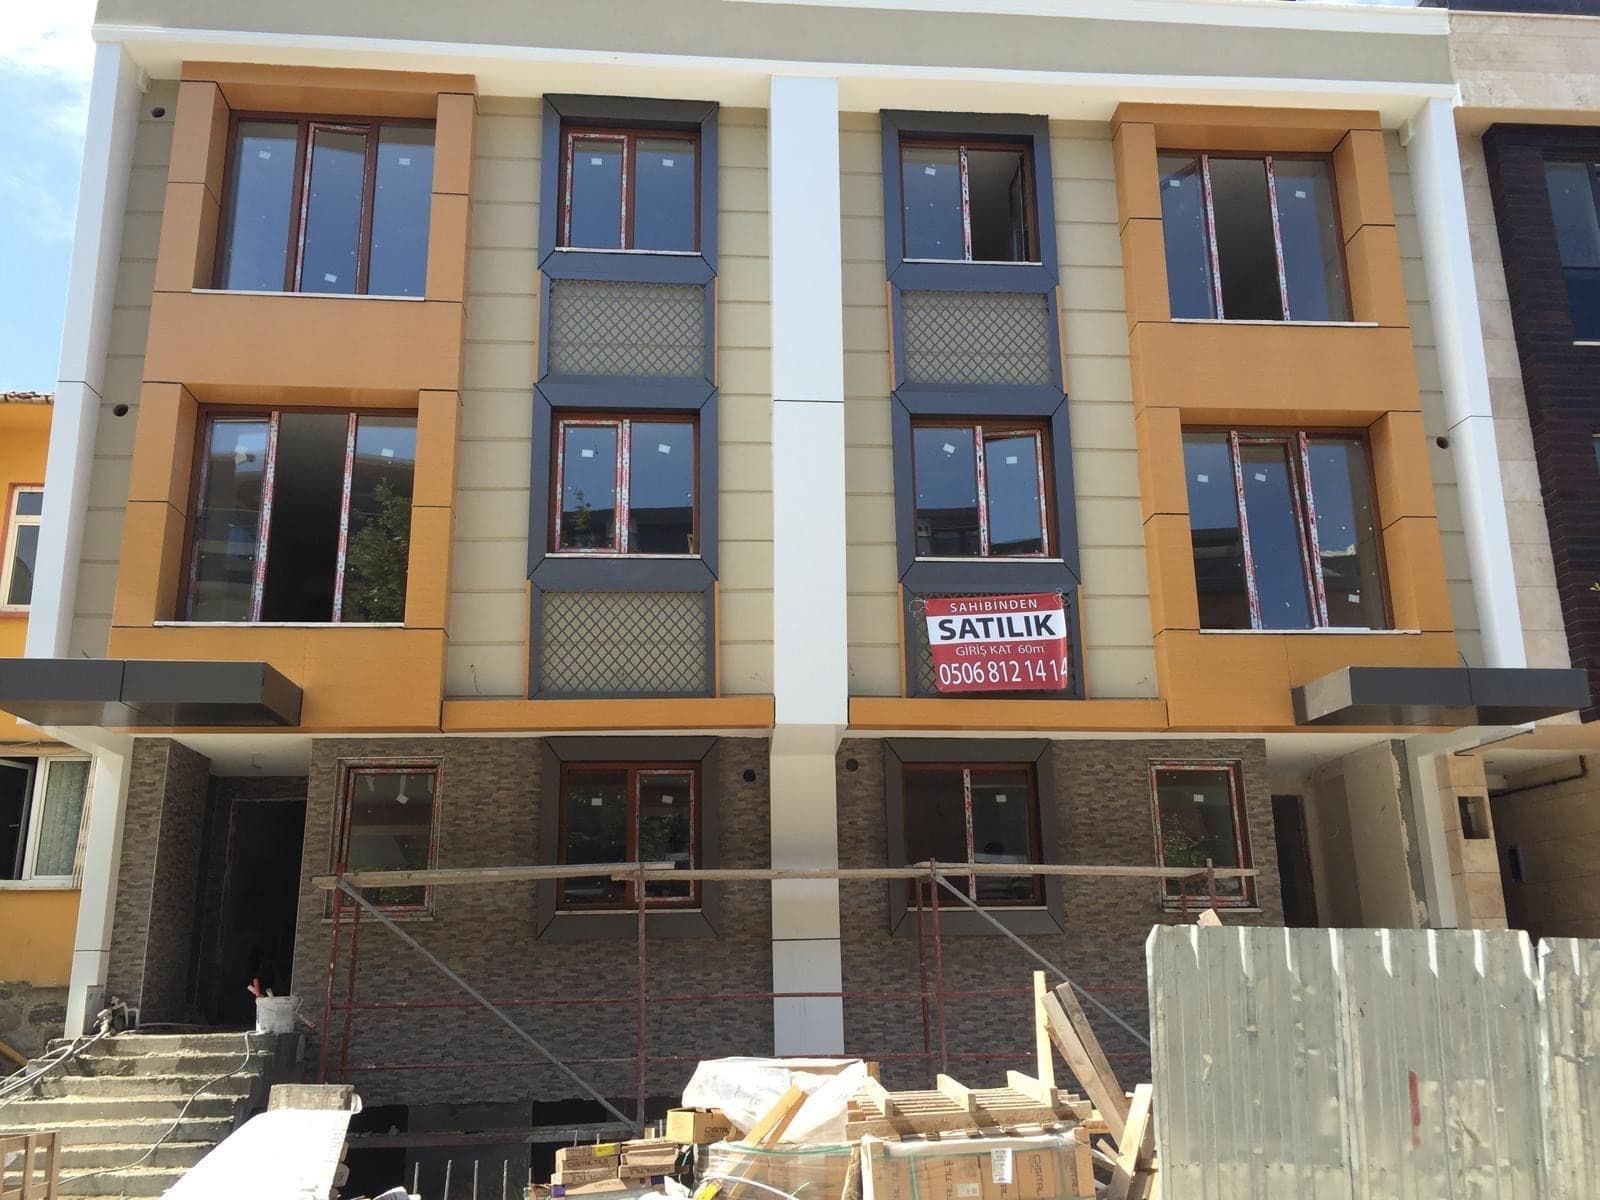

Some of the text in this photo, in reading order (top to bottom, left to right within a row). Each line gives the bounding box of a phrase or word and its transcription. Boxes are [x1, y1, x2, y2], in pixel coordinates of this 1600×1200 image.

[950, 599, 1037, 613] SAHİBİNDEN
[938, 614, 1056, 641] SATILIK
[955, 643, 987, 657] GİRİŞ
[990, 645, 1012, 655] KAT
[940, 661, 985, 685] 0506
[987, 660, 1022, 683] 812
[1024, 659, 1047, 682] 14
